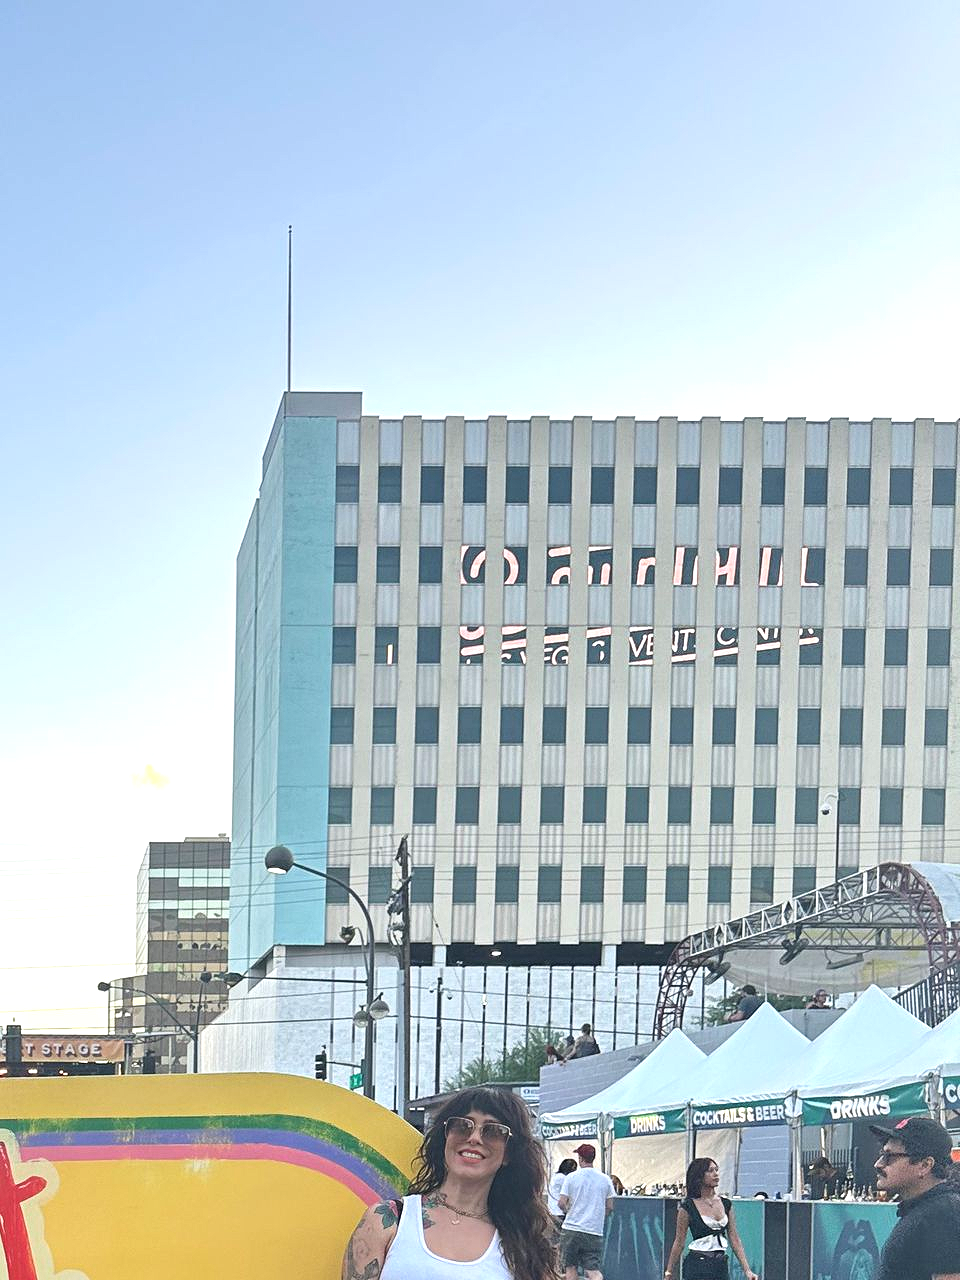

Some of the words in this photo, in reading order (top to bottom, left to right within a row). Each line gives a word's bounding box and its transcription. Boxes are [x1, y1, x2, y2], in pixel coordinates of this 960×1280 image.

[42, 1043, 102, 1057] STAGE
[693, 1108, 746, 1126] COCKTAILS
[755, 1104, 784, 1121] BEER
[829, 1095, 891, 1120] DRINKS
[630, 1114, 666, 1134] DRINKS
